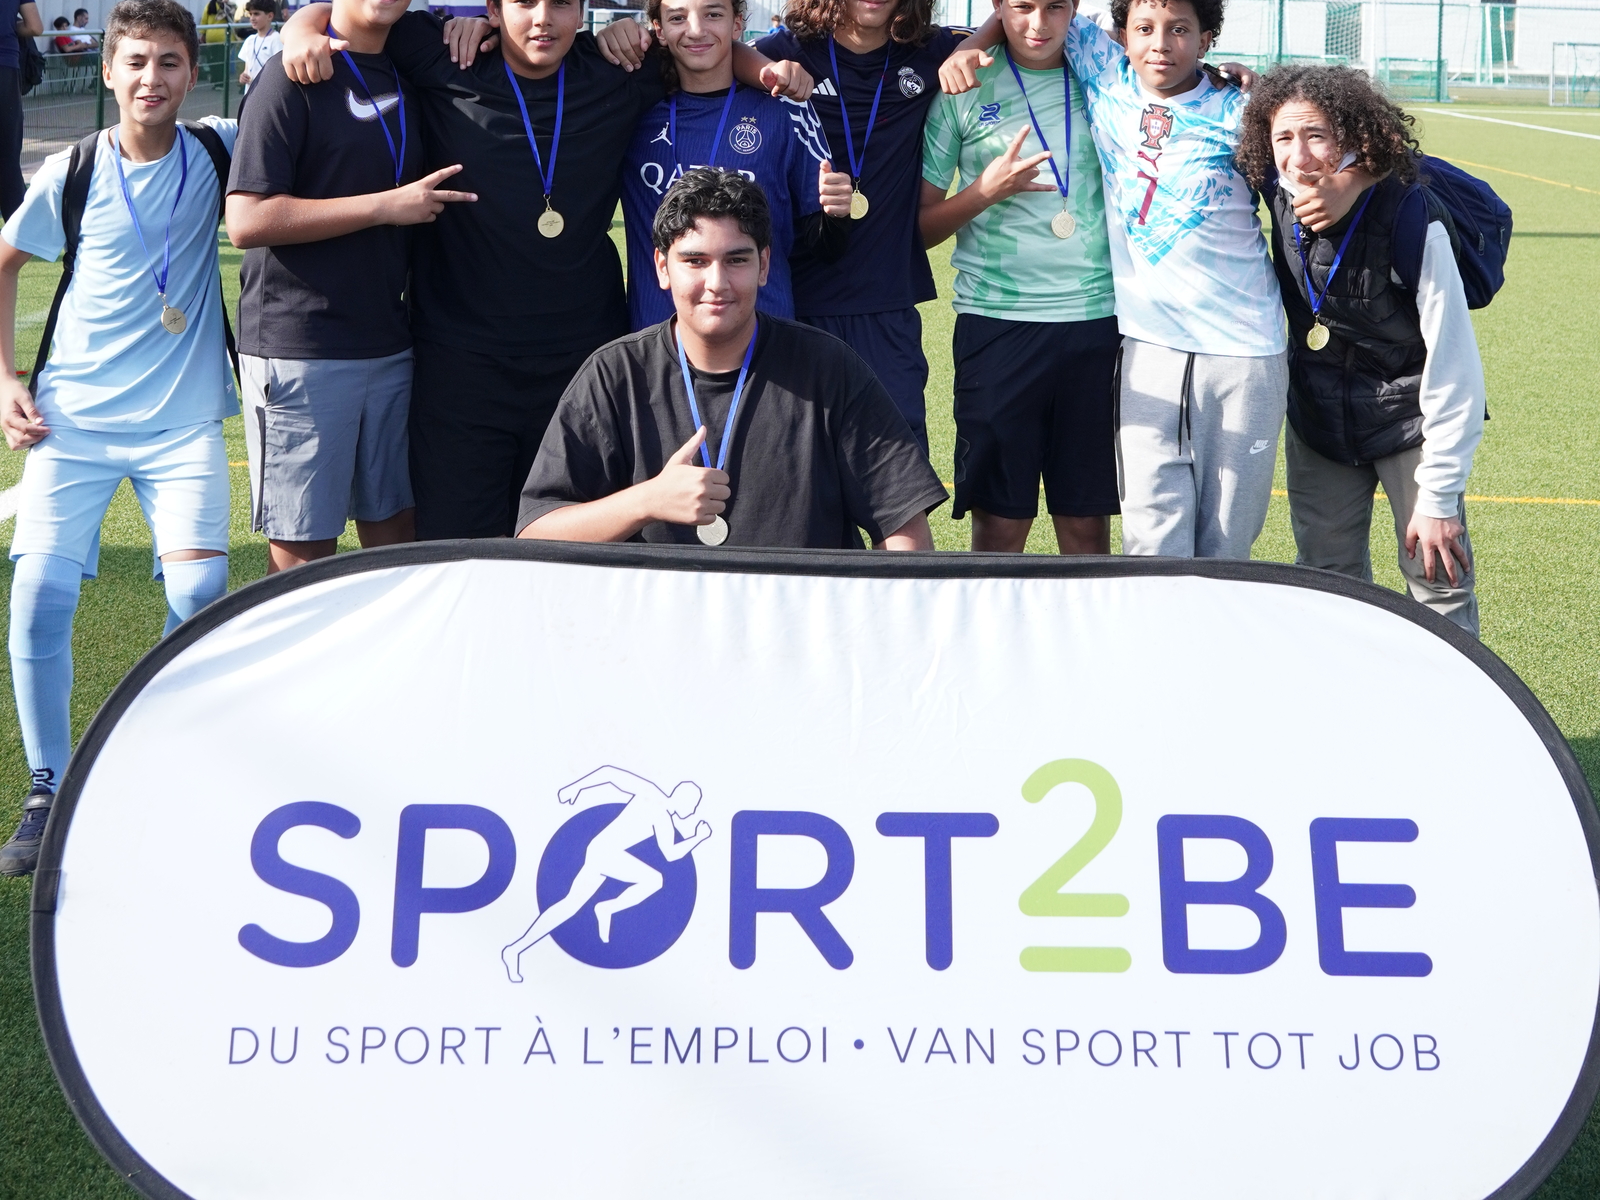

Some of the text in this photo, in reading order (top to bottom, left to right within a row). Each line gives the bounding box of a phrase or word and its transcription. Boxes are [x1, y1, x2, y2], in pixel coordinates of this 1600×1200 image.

[736, 124, 757, 135] PARIS
[1137, 170, 1159, 226] 7
[1253, 439, 1269, 449] NIKE
[238, 758, 1433, 978] SPORT2BE
[229, 1016, 1441, 1072] DU SPORT À L'EMPLOI VAN SPORT TOT JOB
